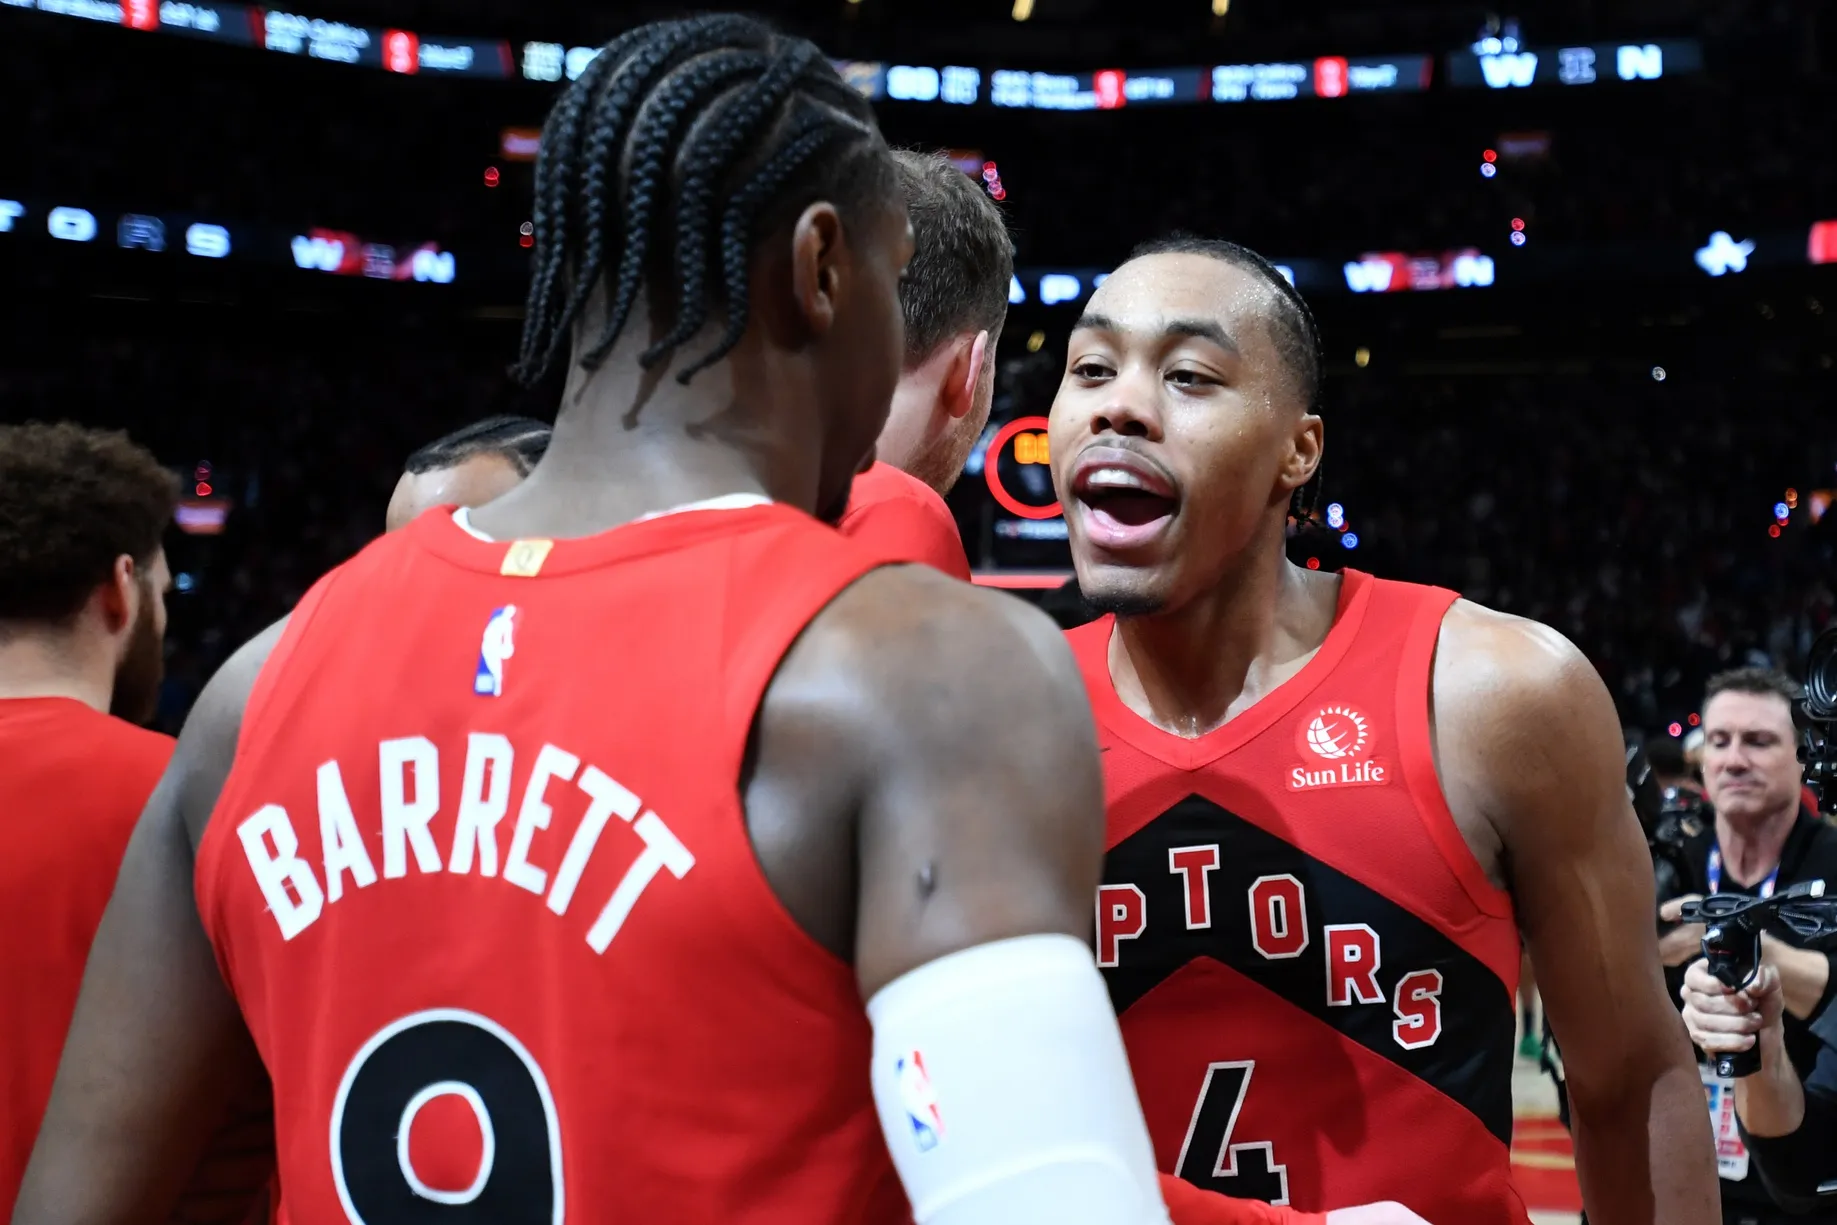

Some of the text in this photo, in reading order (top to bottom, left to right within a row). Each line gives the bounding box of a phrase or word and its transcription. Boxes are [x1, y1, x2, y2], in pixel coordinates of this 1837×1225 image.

[1480, 44, 1662, 88] WIN
[236, 732, 696, 955] BARRETT
[1292, 760, 1385, 788] Sun Life
[1097, 844, 1443, 1050] PTORS
[1174, 1060, 1289, 1206] 4
